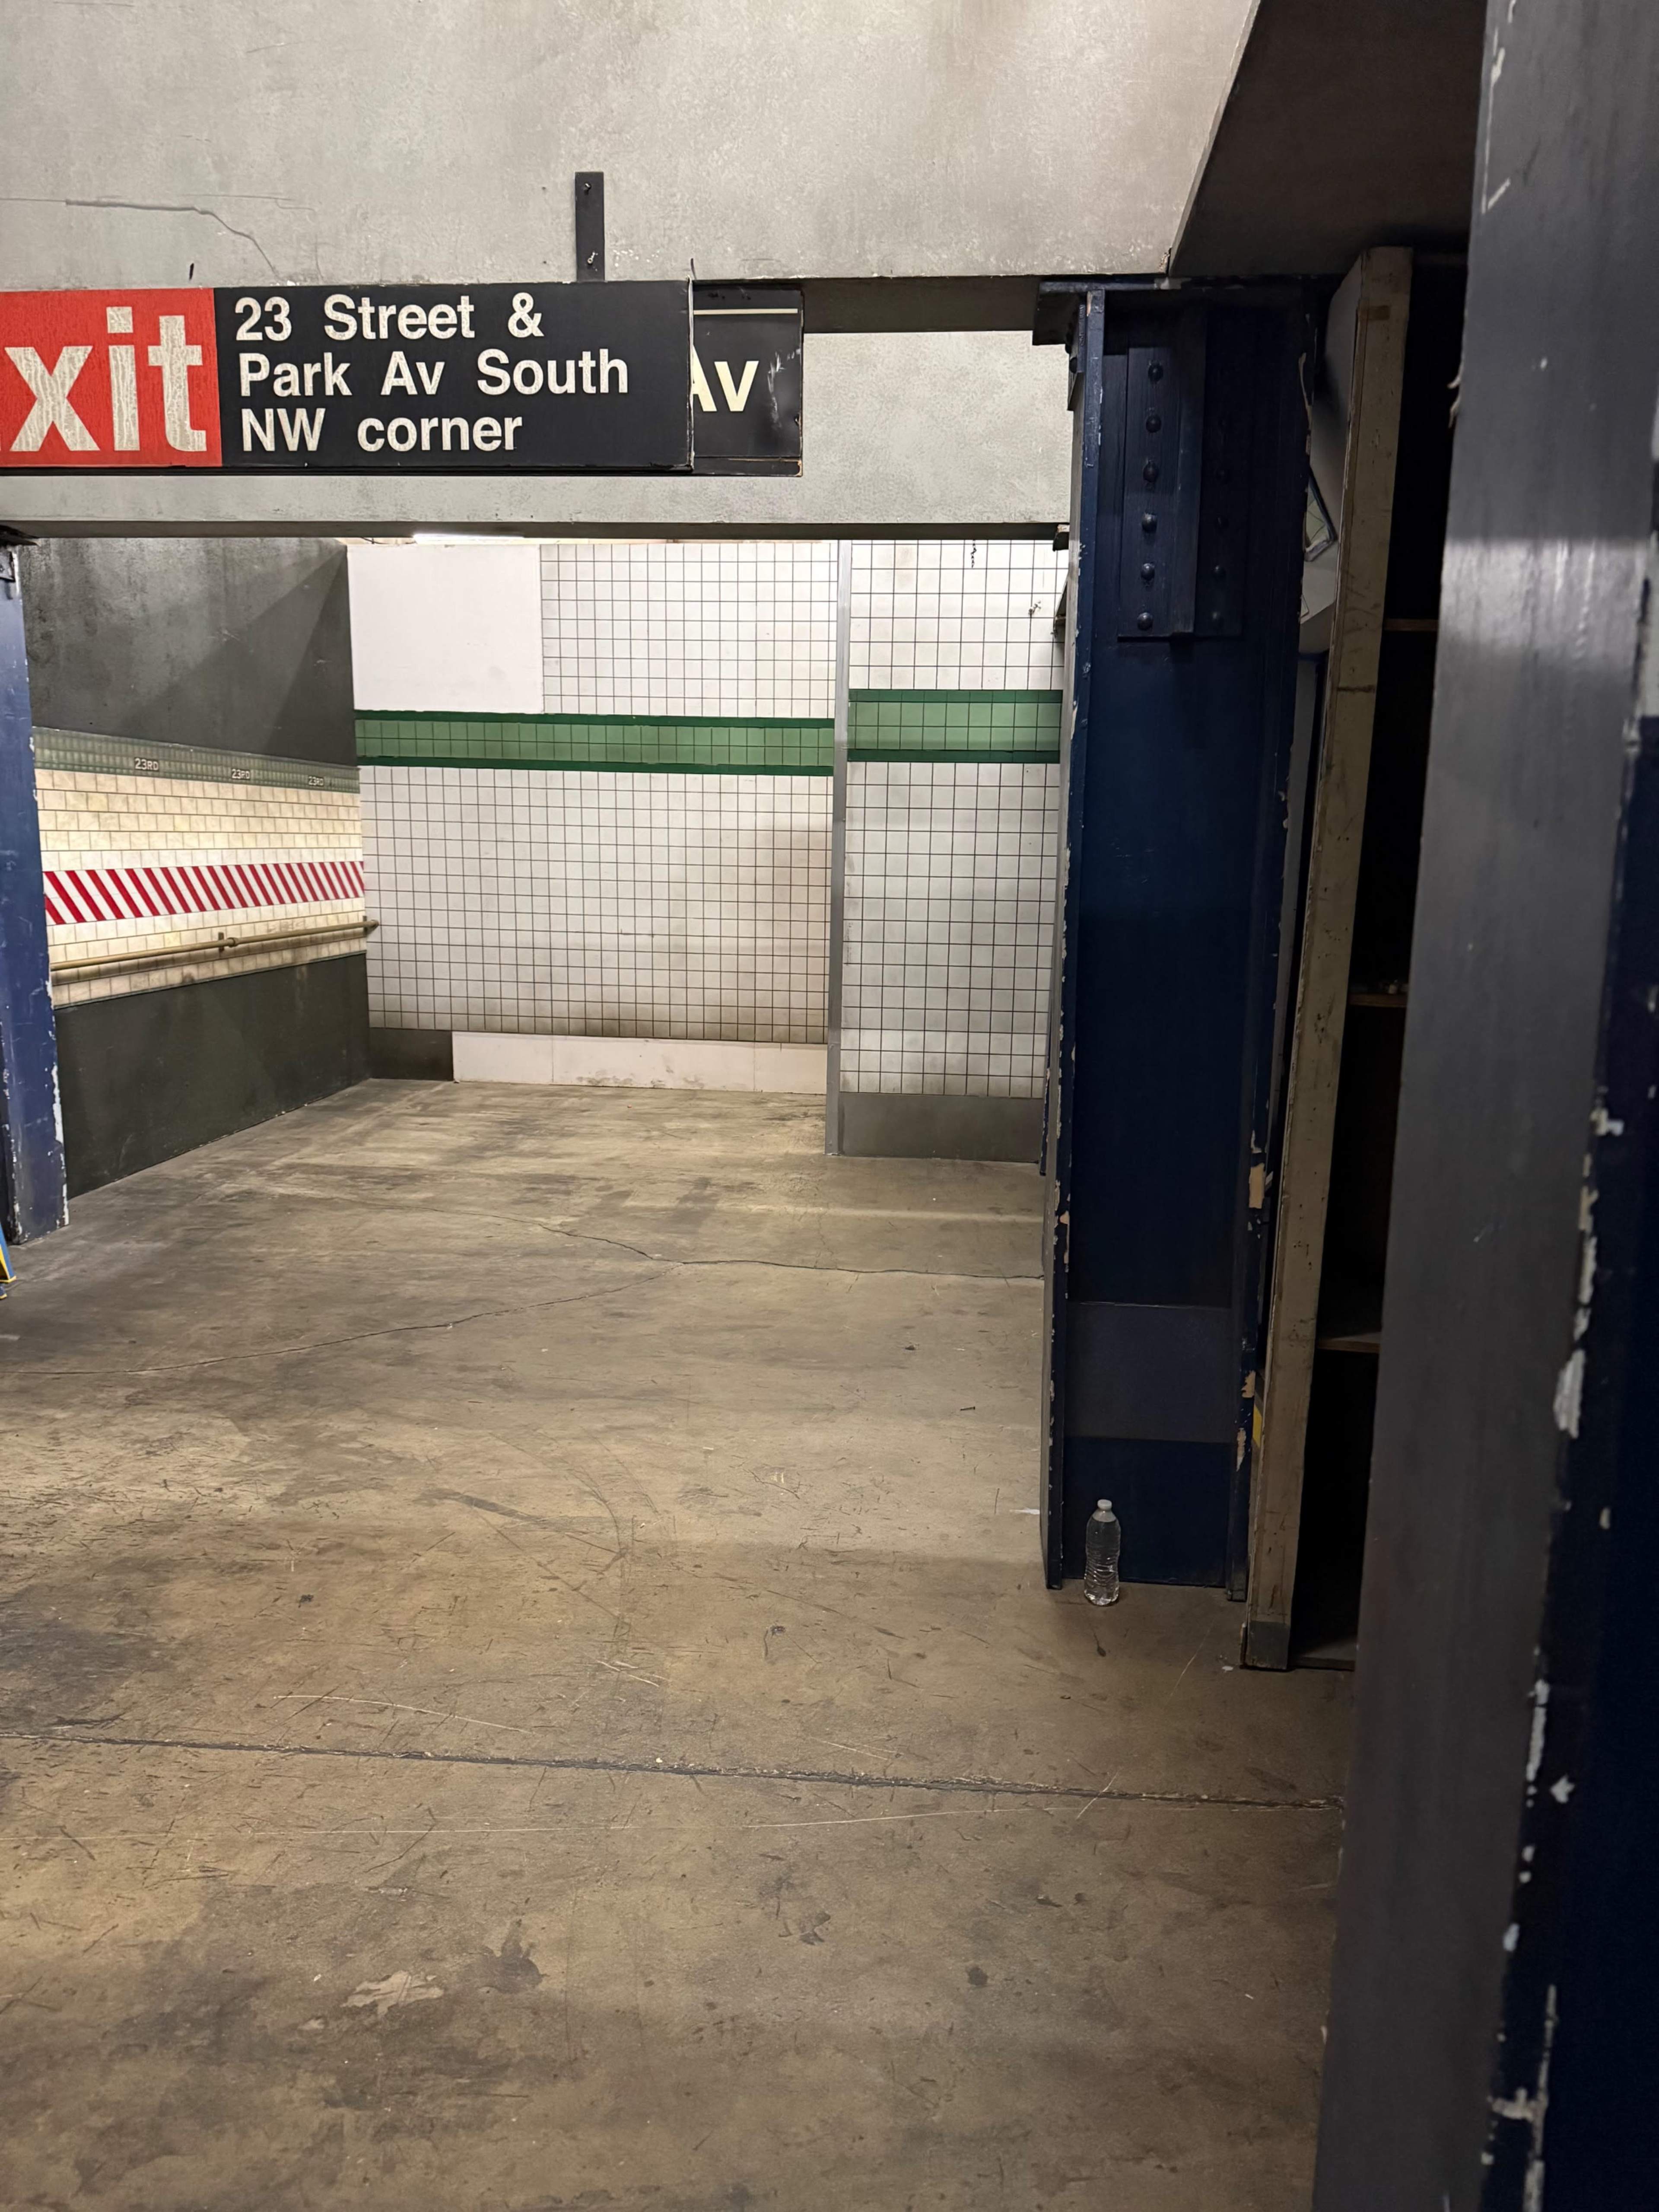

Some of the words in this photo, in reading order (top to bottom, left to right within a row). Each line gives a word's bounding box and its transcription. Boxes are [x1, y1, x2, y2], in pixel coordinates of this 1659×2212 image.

[235, 296, 292, 341] 23
[324, 293, 476, 341] Street
[507, 292, 544, 338] &
[0, 306, 207, 452] xit
[239, 352, 353, 397] Park
[380, 350, 445, 396] Av
[477, 348, 629, 396] South
[241, 407, 326, 452] NW
[357, 416, 523, 452] corner
[134, 757, 159, 770] 23RD
[232, 769, 250, 780] 23RD
